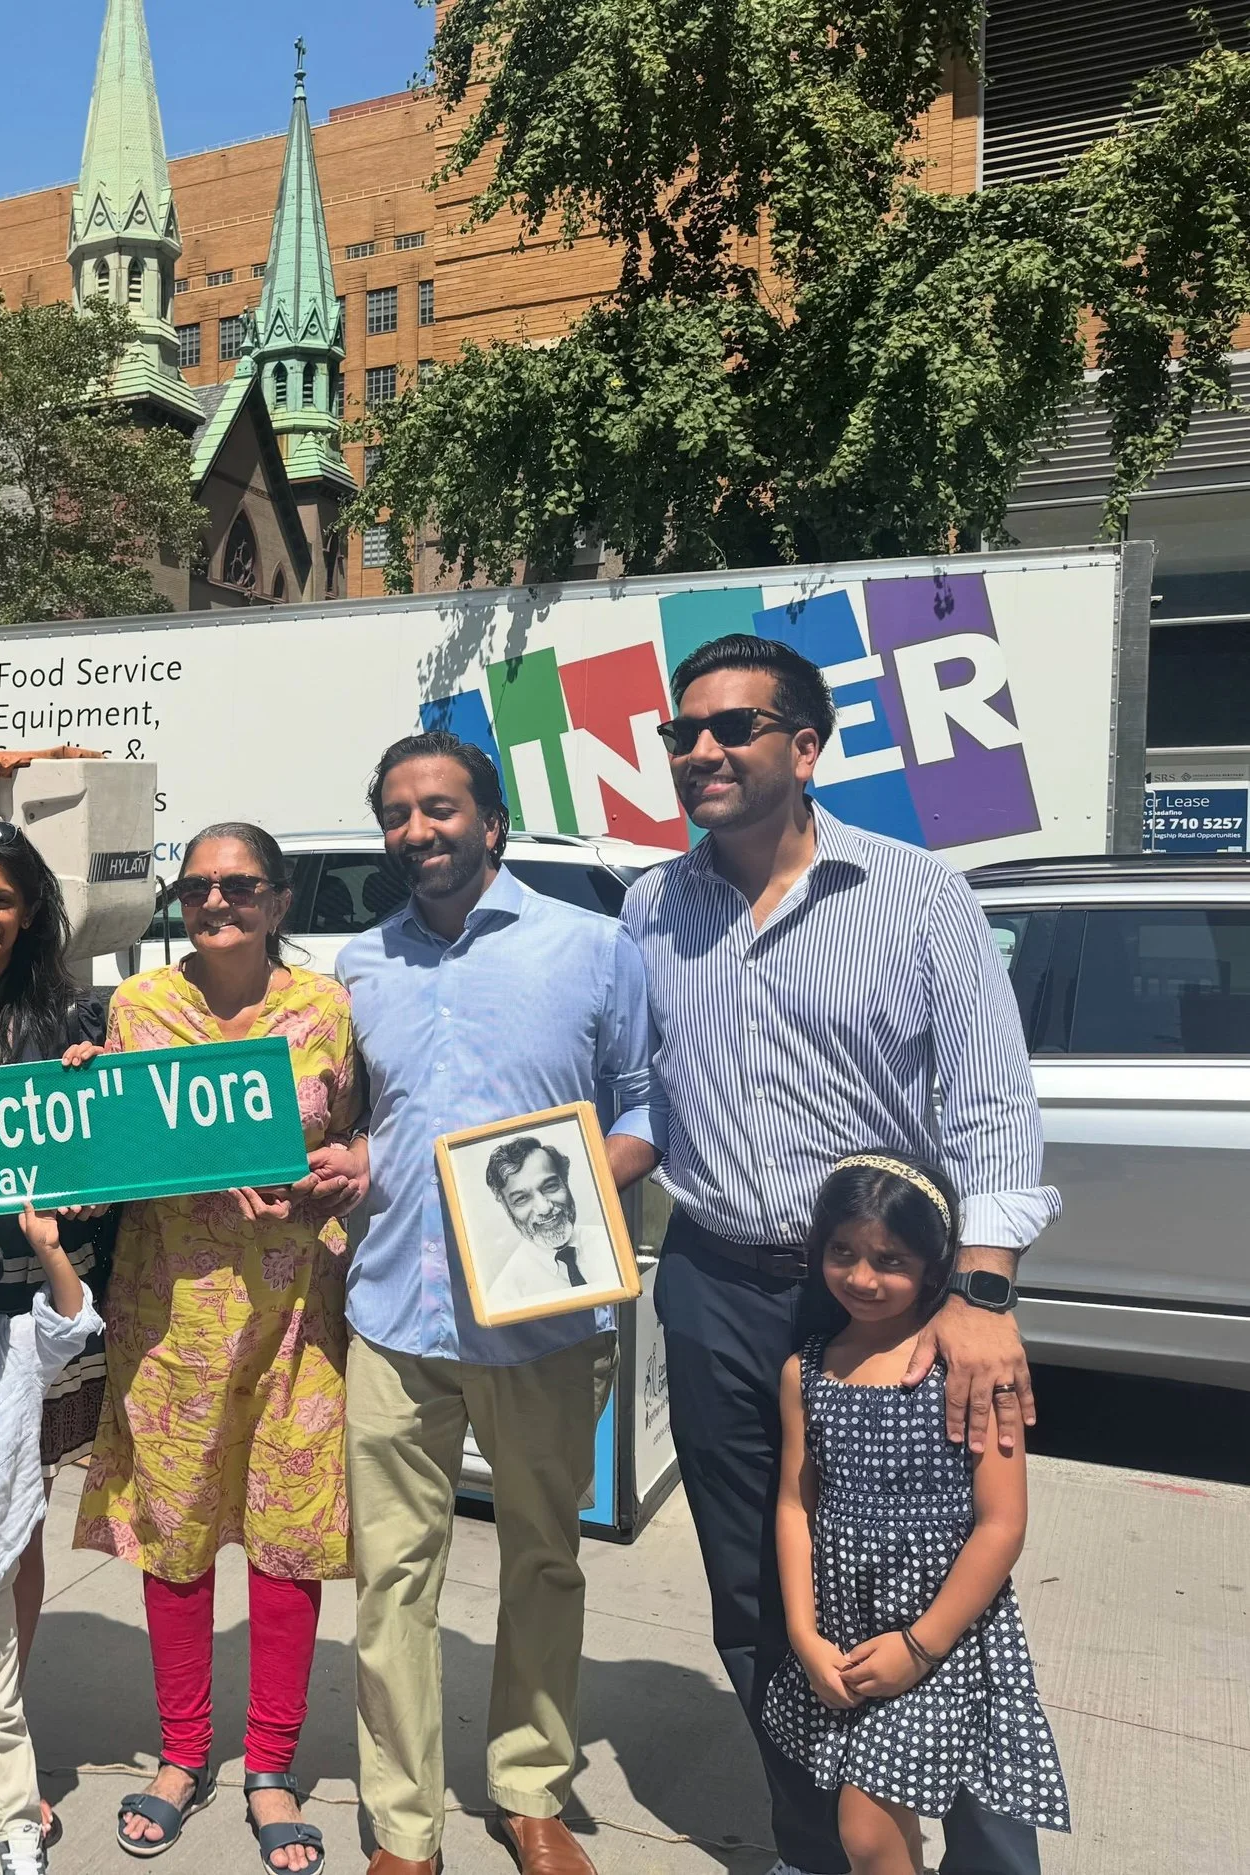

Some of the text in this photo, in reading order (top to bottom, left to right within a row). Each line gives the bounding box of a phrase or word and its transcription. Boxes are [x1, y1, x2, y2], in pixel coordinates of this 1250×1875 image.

[77, 655, 182, 685] Service
[125, 739, 145, 759] &
[1154, 773, 1176, 782] SRS
[1166, 796, 1210, 808] Lease
[1169, 818, 1198, 830] 710
[1202, 817, 1242, 829] 5257
[110, 858, 147, 875] HYLAN
[148, 1060, 273, 1130] Vora
